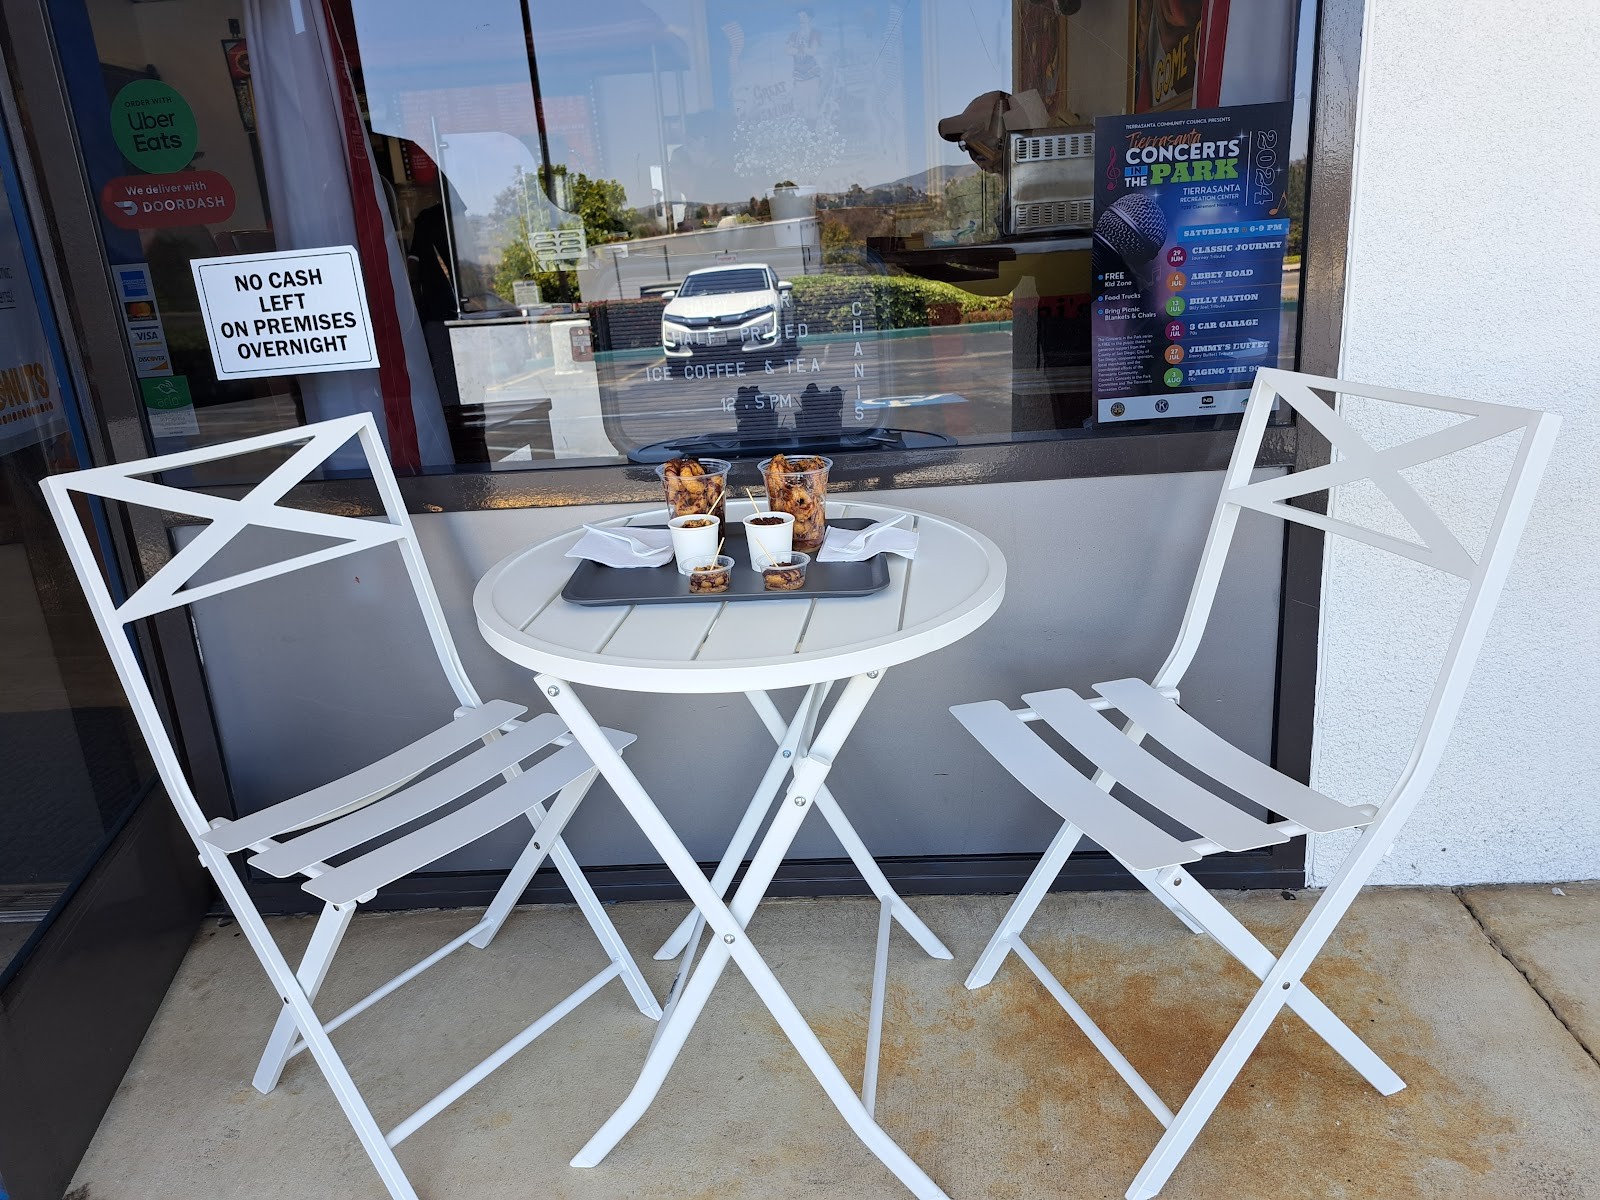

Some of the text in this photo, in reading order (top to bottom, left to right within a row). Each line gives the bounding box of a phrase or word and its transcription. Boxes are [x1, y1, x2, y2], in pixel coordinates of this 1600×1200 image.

[125, 100, 150, 108] ORDER
[128, 113, 175, 131] Uber
[133, 133, 183, 152] Eats
[1126, 128, 1202, 149] Tierrasanta
[1126, 140, 1240, 165] CONCERTS
[1131, 158, 1238, 185] IN PARK
[1254, 130, 1278, 205] 2024
[125, 182, 207, 196] We deliver with
[1125, 176, 1148, 188] THE
[1183, 184, 1241, 195] TIERRASANTA
[143, 196, 225, 213] DOORDASH
[1184, 227, 1240, 237] SATURDAYS
[1192, 241, 1282, 254] CLASSIC JOURNEY
[235, 269, 323, 292] NO CASH
[1105, 272, 1125, 281] FREE
[1192, 269, 1254, 280] ABBEY ROAD
[259, 293, 305, 313] LEFT
[1190, 294, 1258, 305] BILLY NATION
[221, 312, 357, 339] ON PREMISES
[1198, 322, 1217, 330] CAR
[1219, 319, 1258, 328] GARAGE
[136, 332, 159, 341] VISA
[671, 331, 716, 345] HALF
[739, 324, 809, 342] PRICED
[238, 336, 348, 360] OVERNIGHT
[1189, 344, 1231, 353] JIMMY'S
[139, 355, 166, 363] DISCOVER
[852, 302, 864, 421] CHANIS
[646, 358, 821, 382] ICE COFFEE & TEA
[1188, 368, 1225, 377] PAGING
[721, 397, 737, 413] 12
